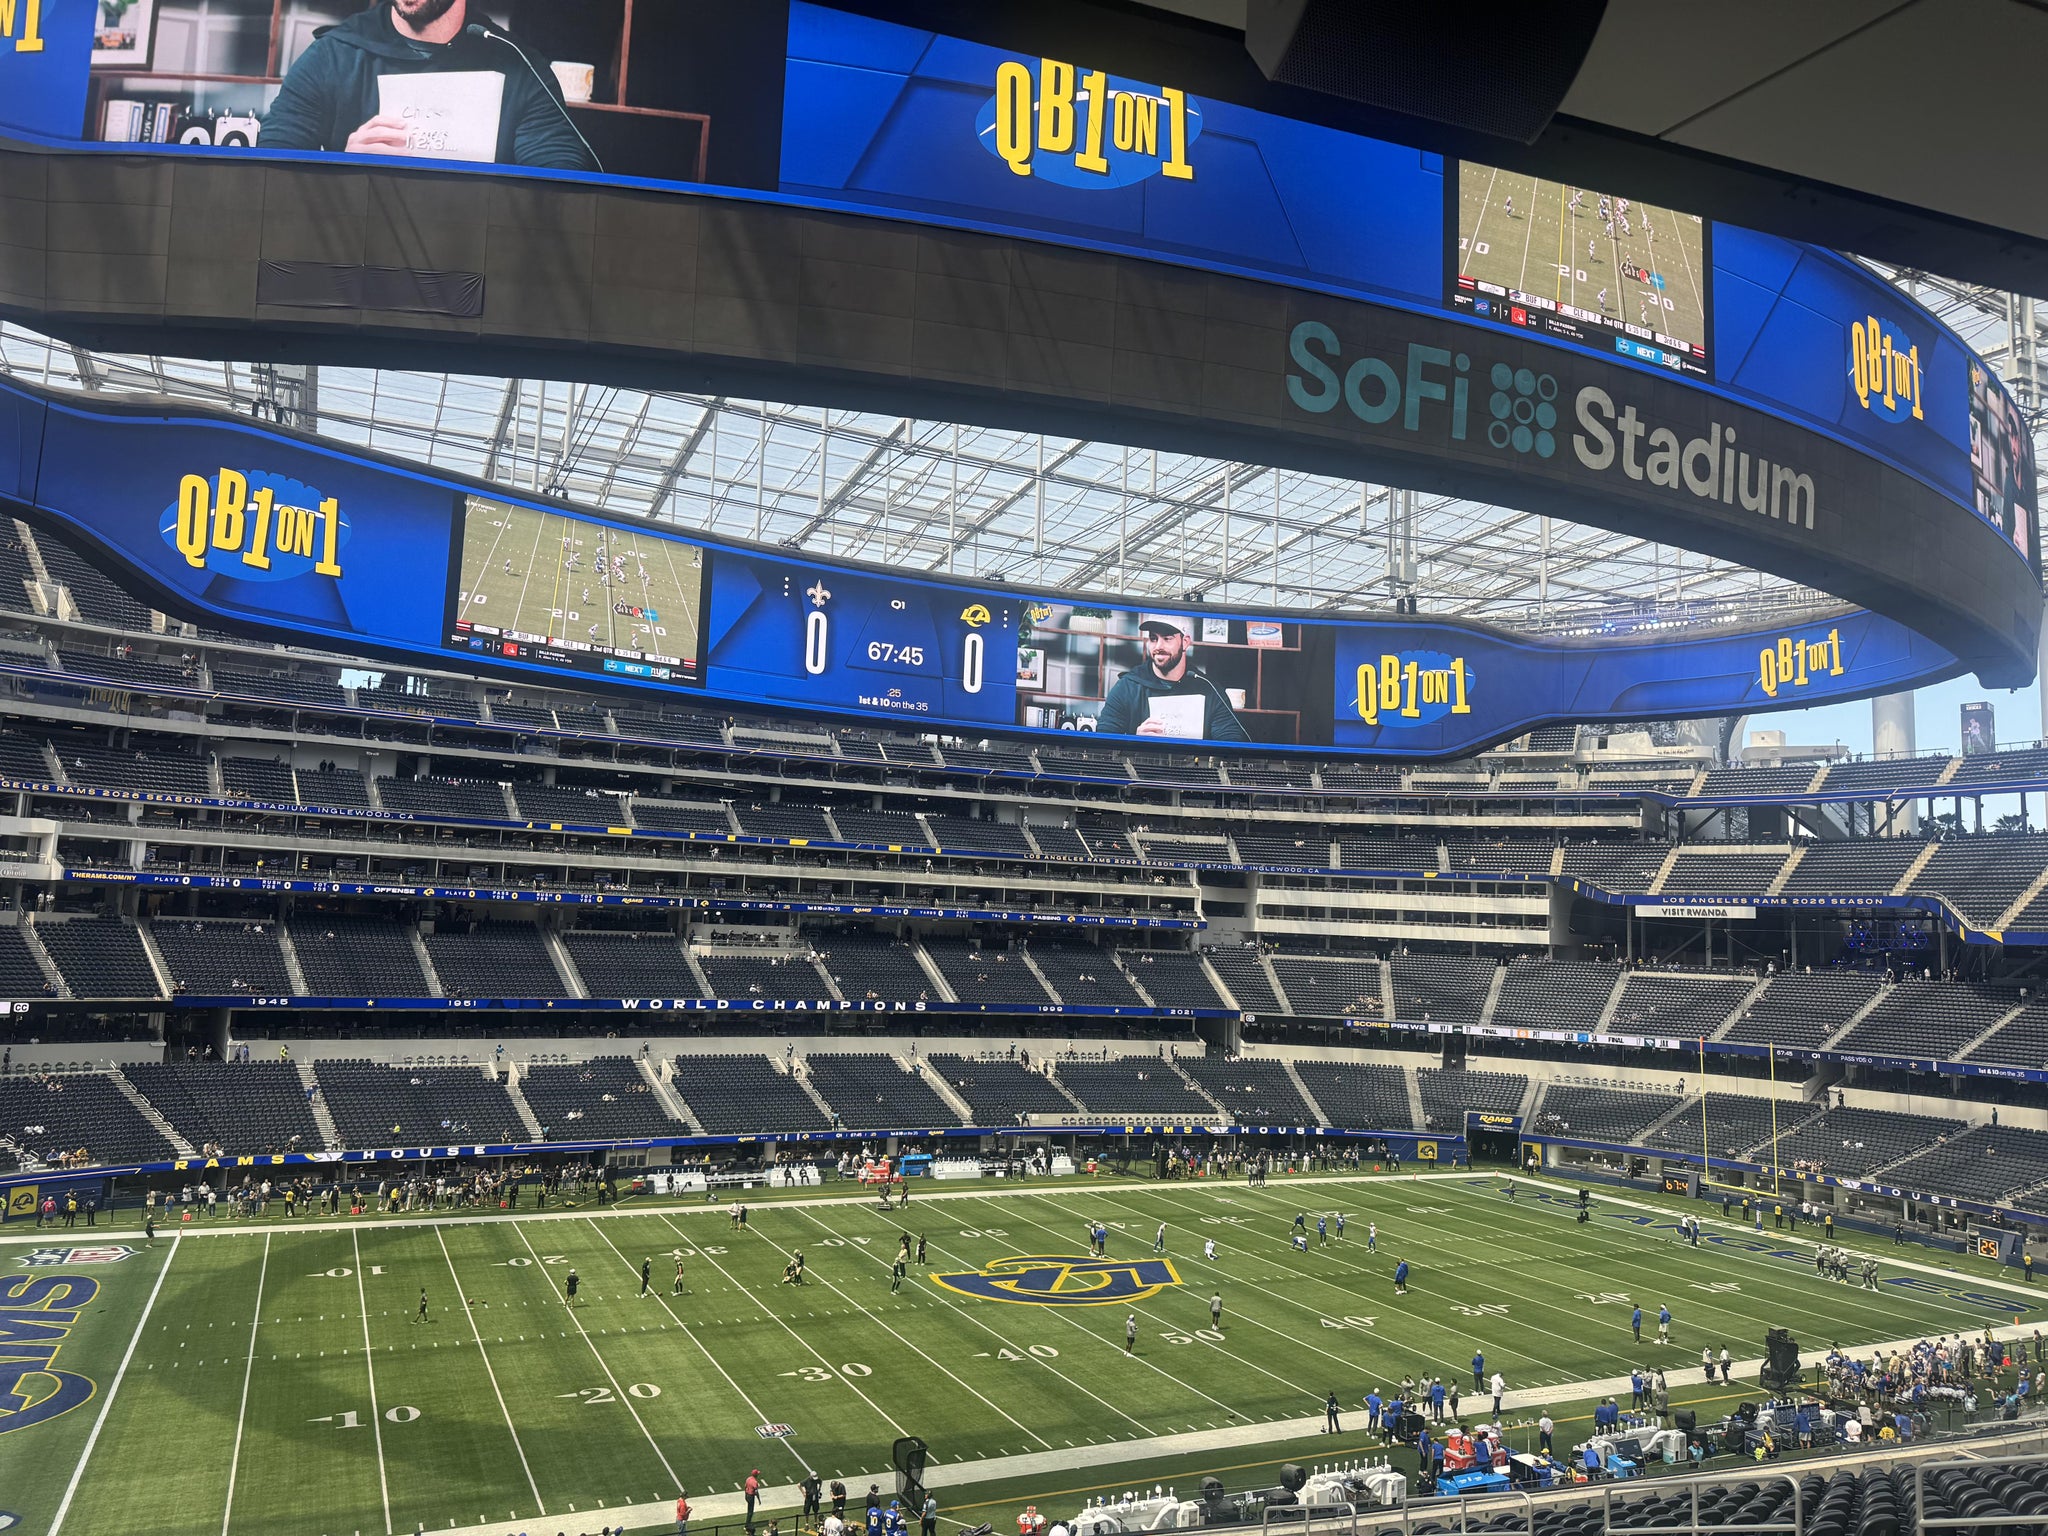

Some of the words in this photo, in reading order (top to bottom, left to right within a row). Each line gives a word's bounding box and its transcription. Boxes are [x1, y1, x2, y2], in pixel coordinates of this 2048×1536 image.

[1162, 86, 1193, 179] 1
[1648, 291, 1675, 311] 30
[1636, 346, 1656, 360] NEXT
[1286, 320, 1470, 441] SoFi
[1909, 345, 1924, 421] 1
[1573, 385, 1816, 530] Stadium
[315, 497, 341, 577] 1
[639, 624, 666, 636] 30
[805, 611, 828, 675] 0
[868, 641, 924, 666] 67:45
[962, 633, 984, 694] 0
[1828, 628, 1844, 677] 1
[625, 664, 644, 674] NEXT
[1450, 656, 1471, 714] 1
[859, 695, 871, 705] 1st
[871, 697, 879, 706] &
[879, 698, 890, 707] 10
[891, 701, 901, 709] on
[902, 701, 915, 710] the
[916, 702, 928, 712] 35
[57, 786, 96, 796] RAMS
[147, 793, 202, 804] SEASON
[218, 800, 248, 808] SOFI
[253, 802, 312, 814] STADIUM,
[318, 807, 394, 820] INGLEWOOD,
[1044, 854, 1084, 863] ANGELES
[1141, 860, 1175, 868] SEASON
[71, 871, 137, 881] THERAMS.COM/NY
[182, 876, 191, 885] 0
[233, 879, 241, 888] 0
[284, 881, 292, 890] 0
[332, 884, 340, 892] 0
[373, 886, 416, 894] OFFENSE
[469, 890, 476, 898] 0
[511, 892, 518, 900] 0
[555, 894, 562, 902] 0
[1662, 896, 1687, 904] LOS
[1690, 897, 1749, 905] ANGELES
[1753, 897, 1789, 905] RAMS
[1792, 897, 1825, 905] 2026
[1830, 897, 1883, 905] SEASON
[1661, 907, 1685, 917] VISIT
[1686, 908, 1728, 917] RWANDA
[14, 1003, 27, 1012] CC
[252, 997, 288, 1006] 1945
[622, 999, 730, 1010] WORLD
[752, 1000, 927, 1011] CHAMPIONS
[1353, 1020, 1390, 1028] SCORES
[1479, 1114, 1514, 1124] RAMS
[1125, 1126, 1193, 1135] RAMS
[1241, 1126, 1325, 1136] HOUSE
[174, 1154, 285, 1171] RAMS
[363, 1145, 486, 1160] HOUSE
[1761, 1166, 1825, 1184] RAMS
[1873, 1185, 1958, 1208] HOUSE
[1981, 1239, 1997, 1256] 25
[1449, 1302, 1512, 1318] 30
[1319, 1315, 1378, 1330] 40
[1159, 1328, 1226, 1345] 50
[995, 1344, 1060, 1363] 40
[796, 1361, 874, 1383] 30
[577, 1382, 662, 1405] 20
[334, 1405, 421, 1430] 10
[1449, 1461, 1456, 1470] G
[869, 1516, 879, 1527] 10
[886, 1516, 892, 1528] 9
